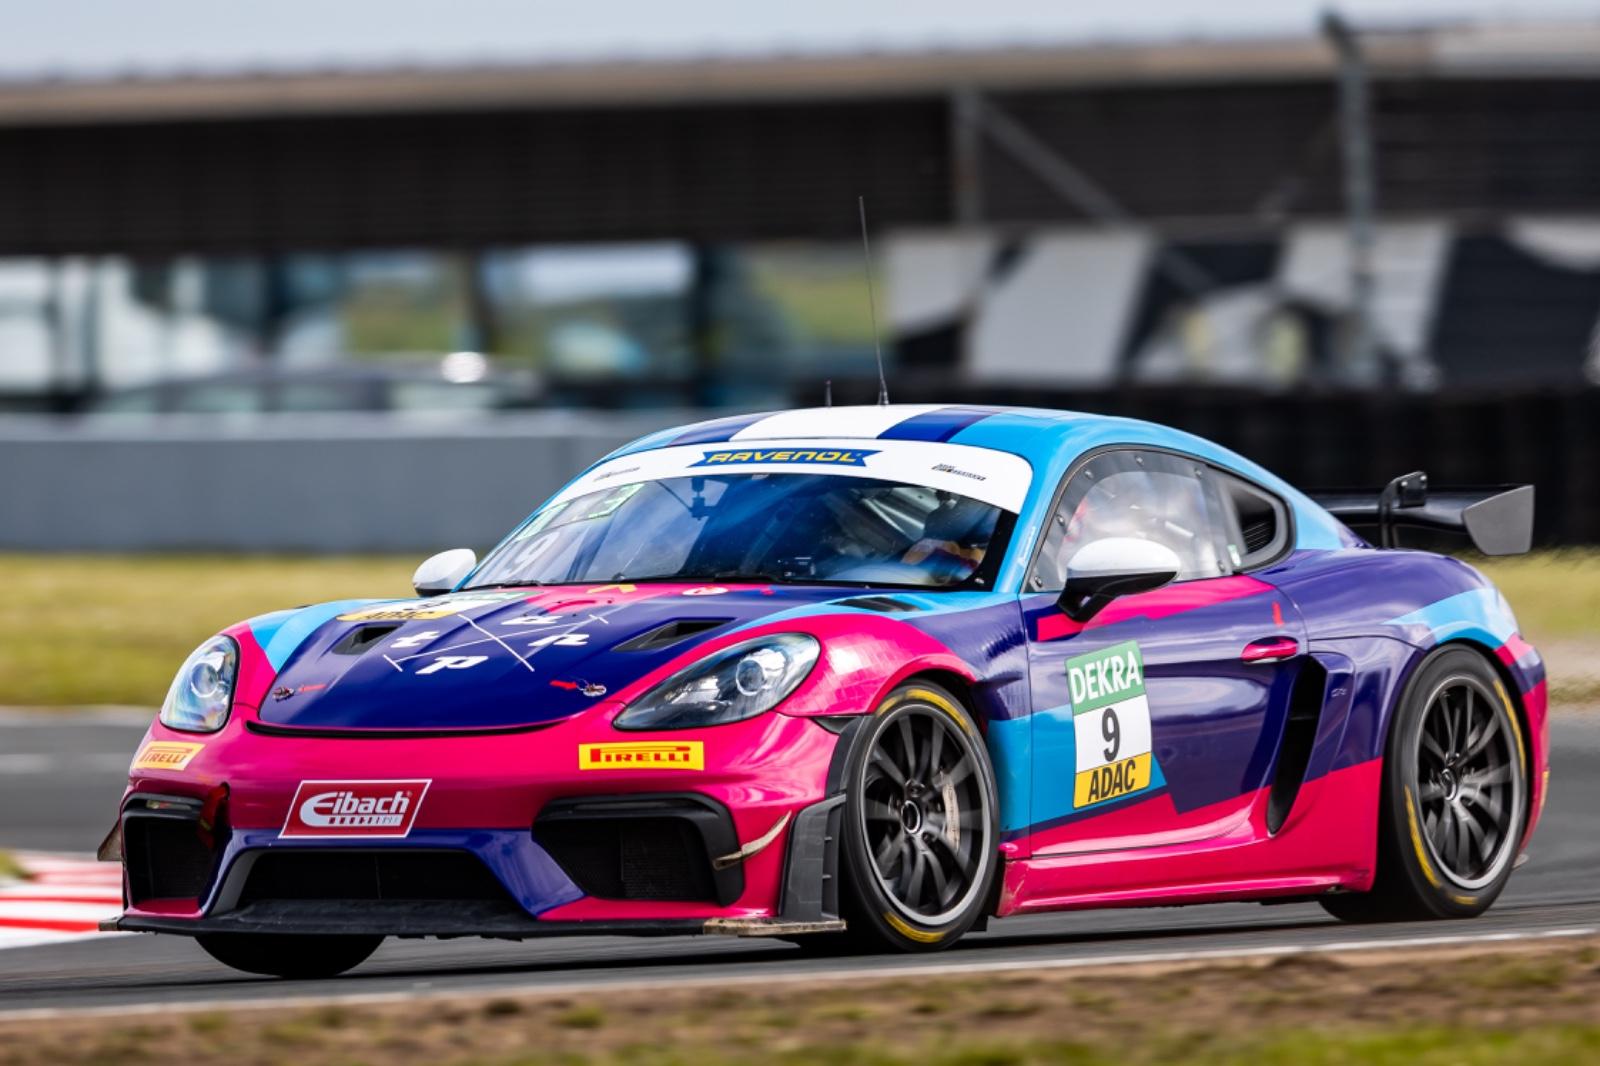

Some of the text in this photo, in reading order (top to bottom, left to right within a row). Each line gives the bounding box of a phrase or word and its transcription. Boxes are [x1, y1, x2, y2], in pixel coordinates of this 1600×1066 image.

[706, 451, 857, 463] RAVENOL
[1069, 651, 1142, 704] DEKRA
[590, 746, 690, 762] PIRELLI
[1102, 708, 1120, 762] 9
[1088, 760, 1136, 802] ADAC
[299, 791, 410, 827] Eibach
